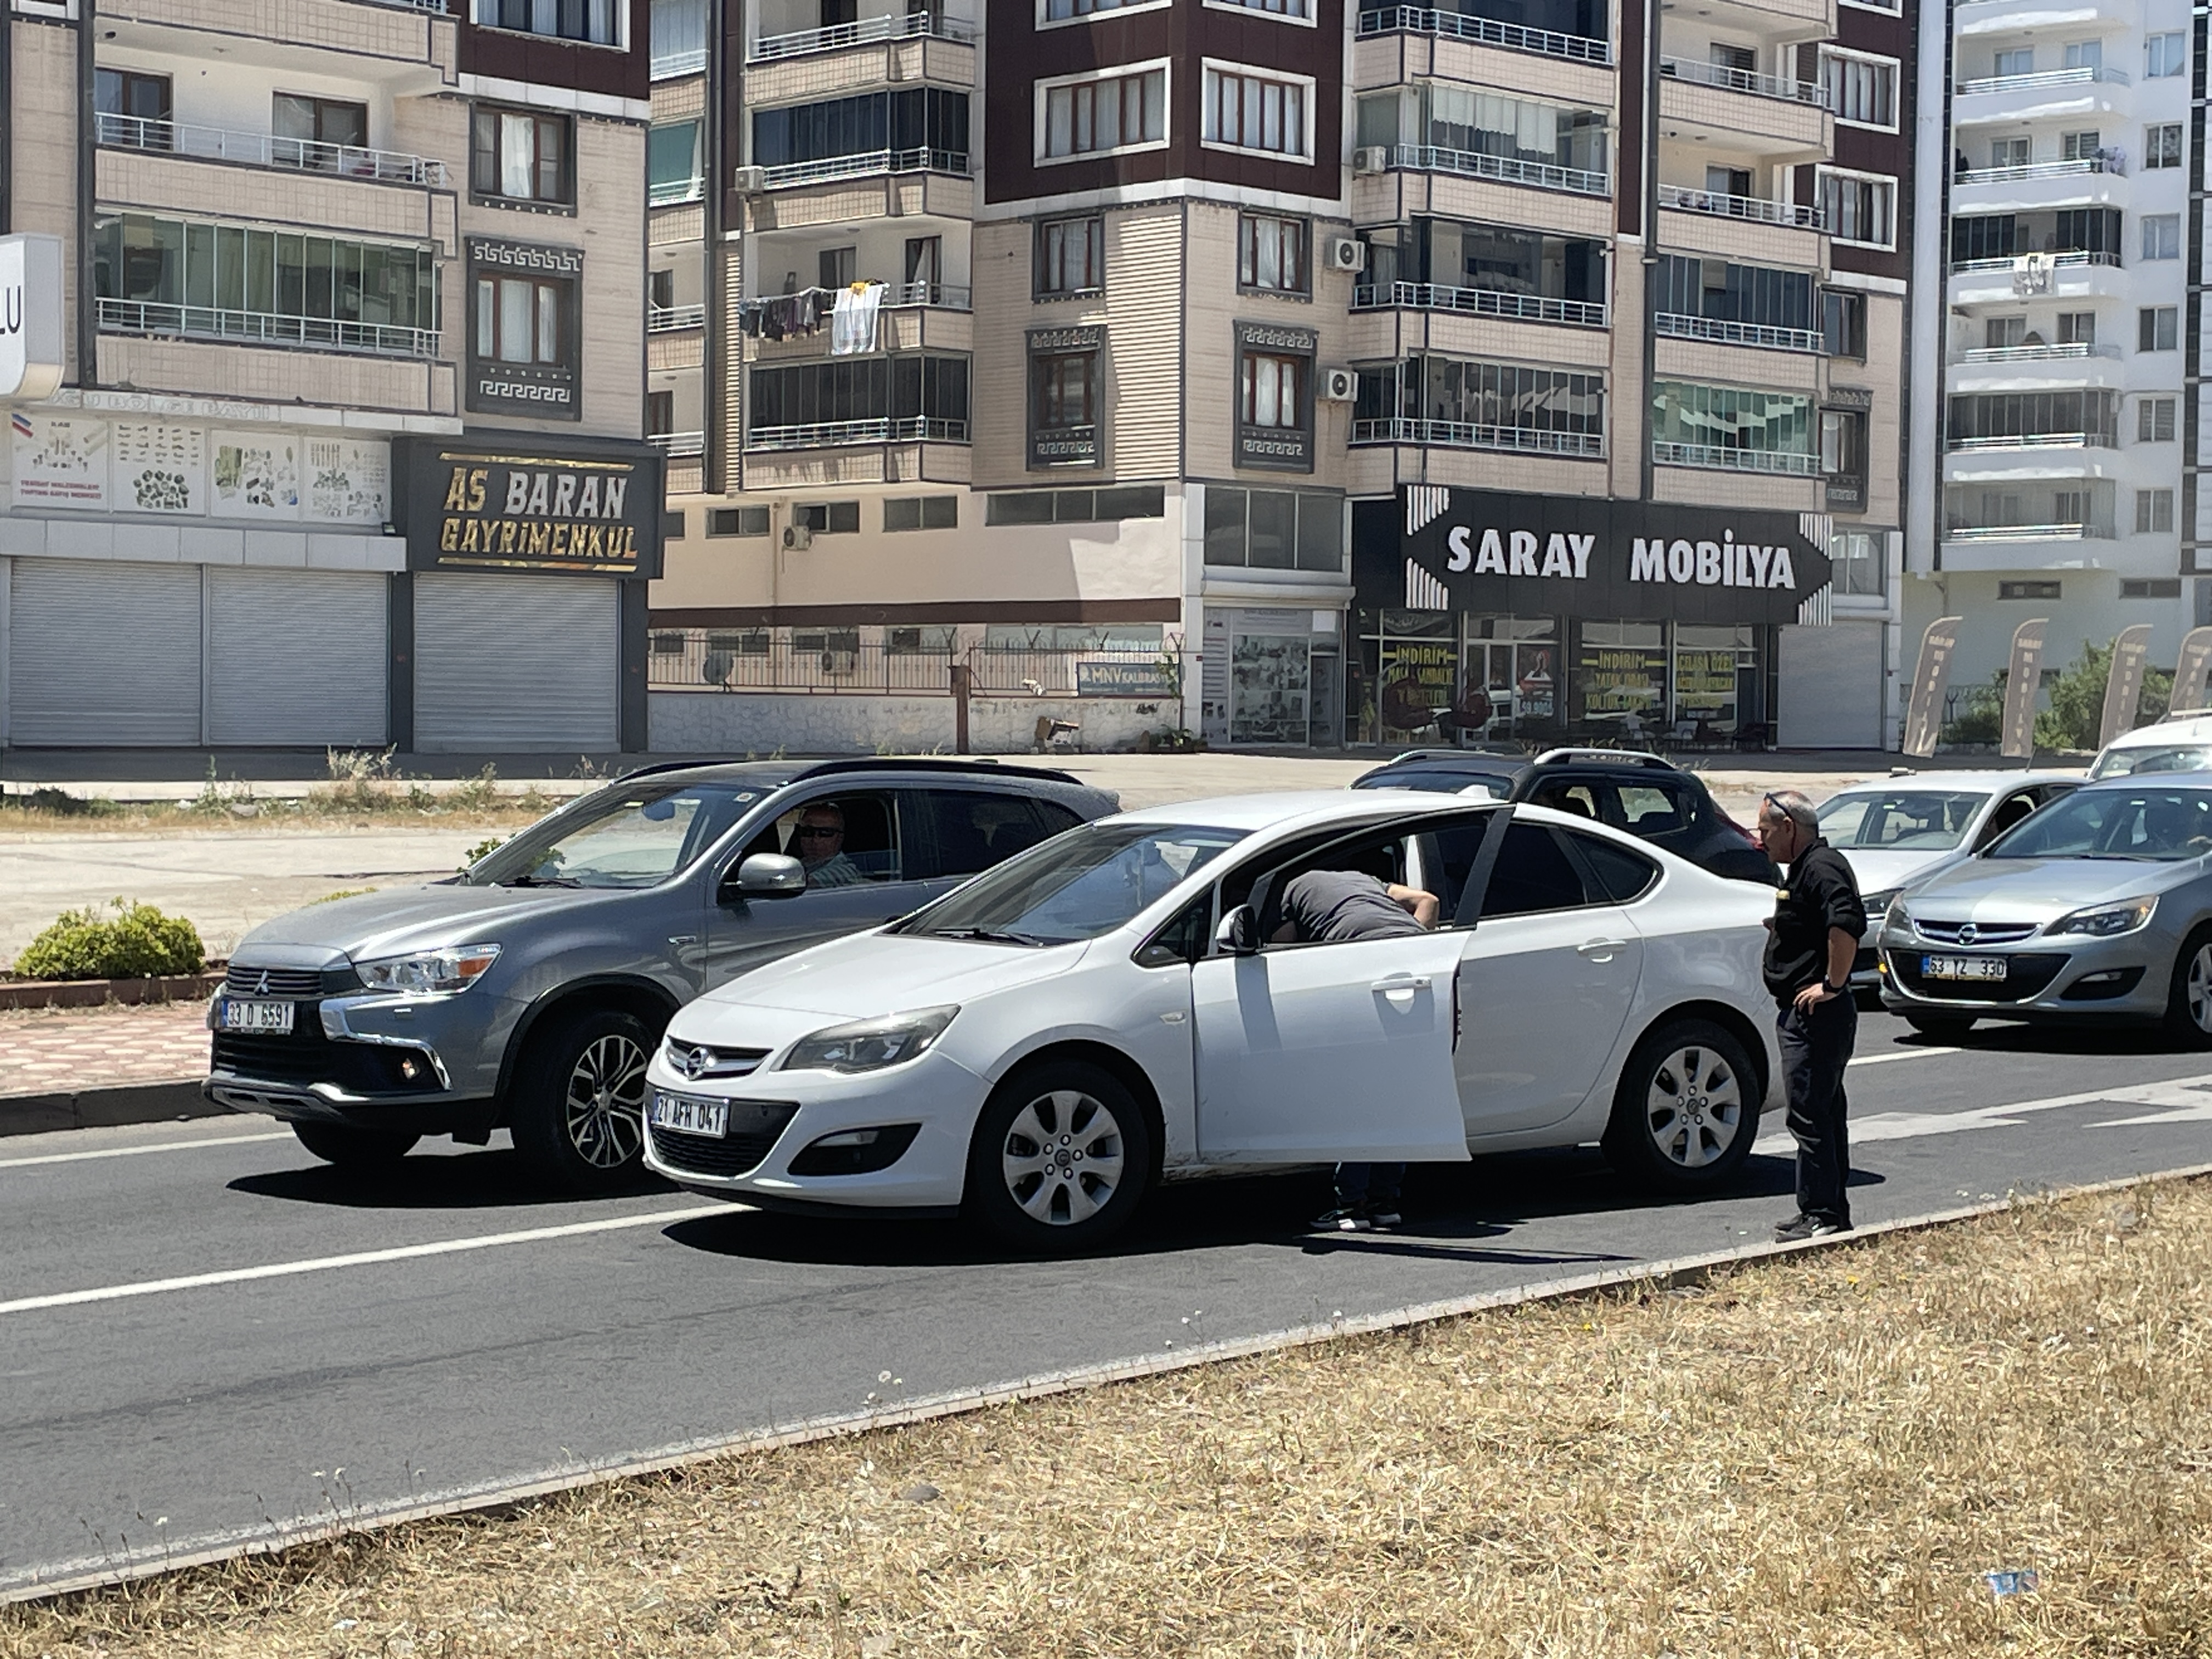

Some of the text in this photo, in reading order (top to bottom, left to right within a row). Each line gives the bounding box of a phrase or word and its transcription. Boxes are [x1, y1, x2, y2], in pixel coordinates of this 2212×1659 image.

[0, 285, 21, 334] U
[444, 467, 628, 520] AS BARAN
[441, 517, 638, 559] GAYRİMENKUL
[1447, 525, 1796, 589] SARAY MOBİLYA
[1396, 645, 1448, 665] İNDİRİM
[1598, 650, 1645, 669] İNDİRİM
[1091, 666, 1122, 684] MNV
[1931, 957, 2004, 975] 63 YZ 330
[229, 1003, 241, 1025] 33
[698, 1104, 720, 1132] 041
